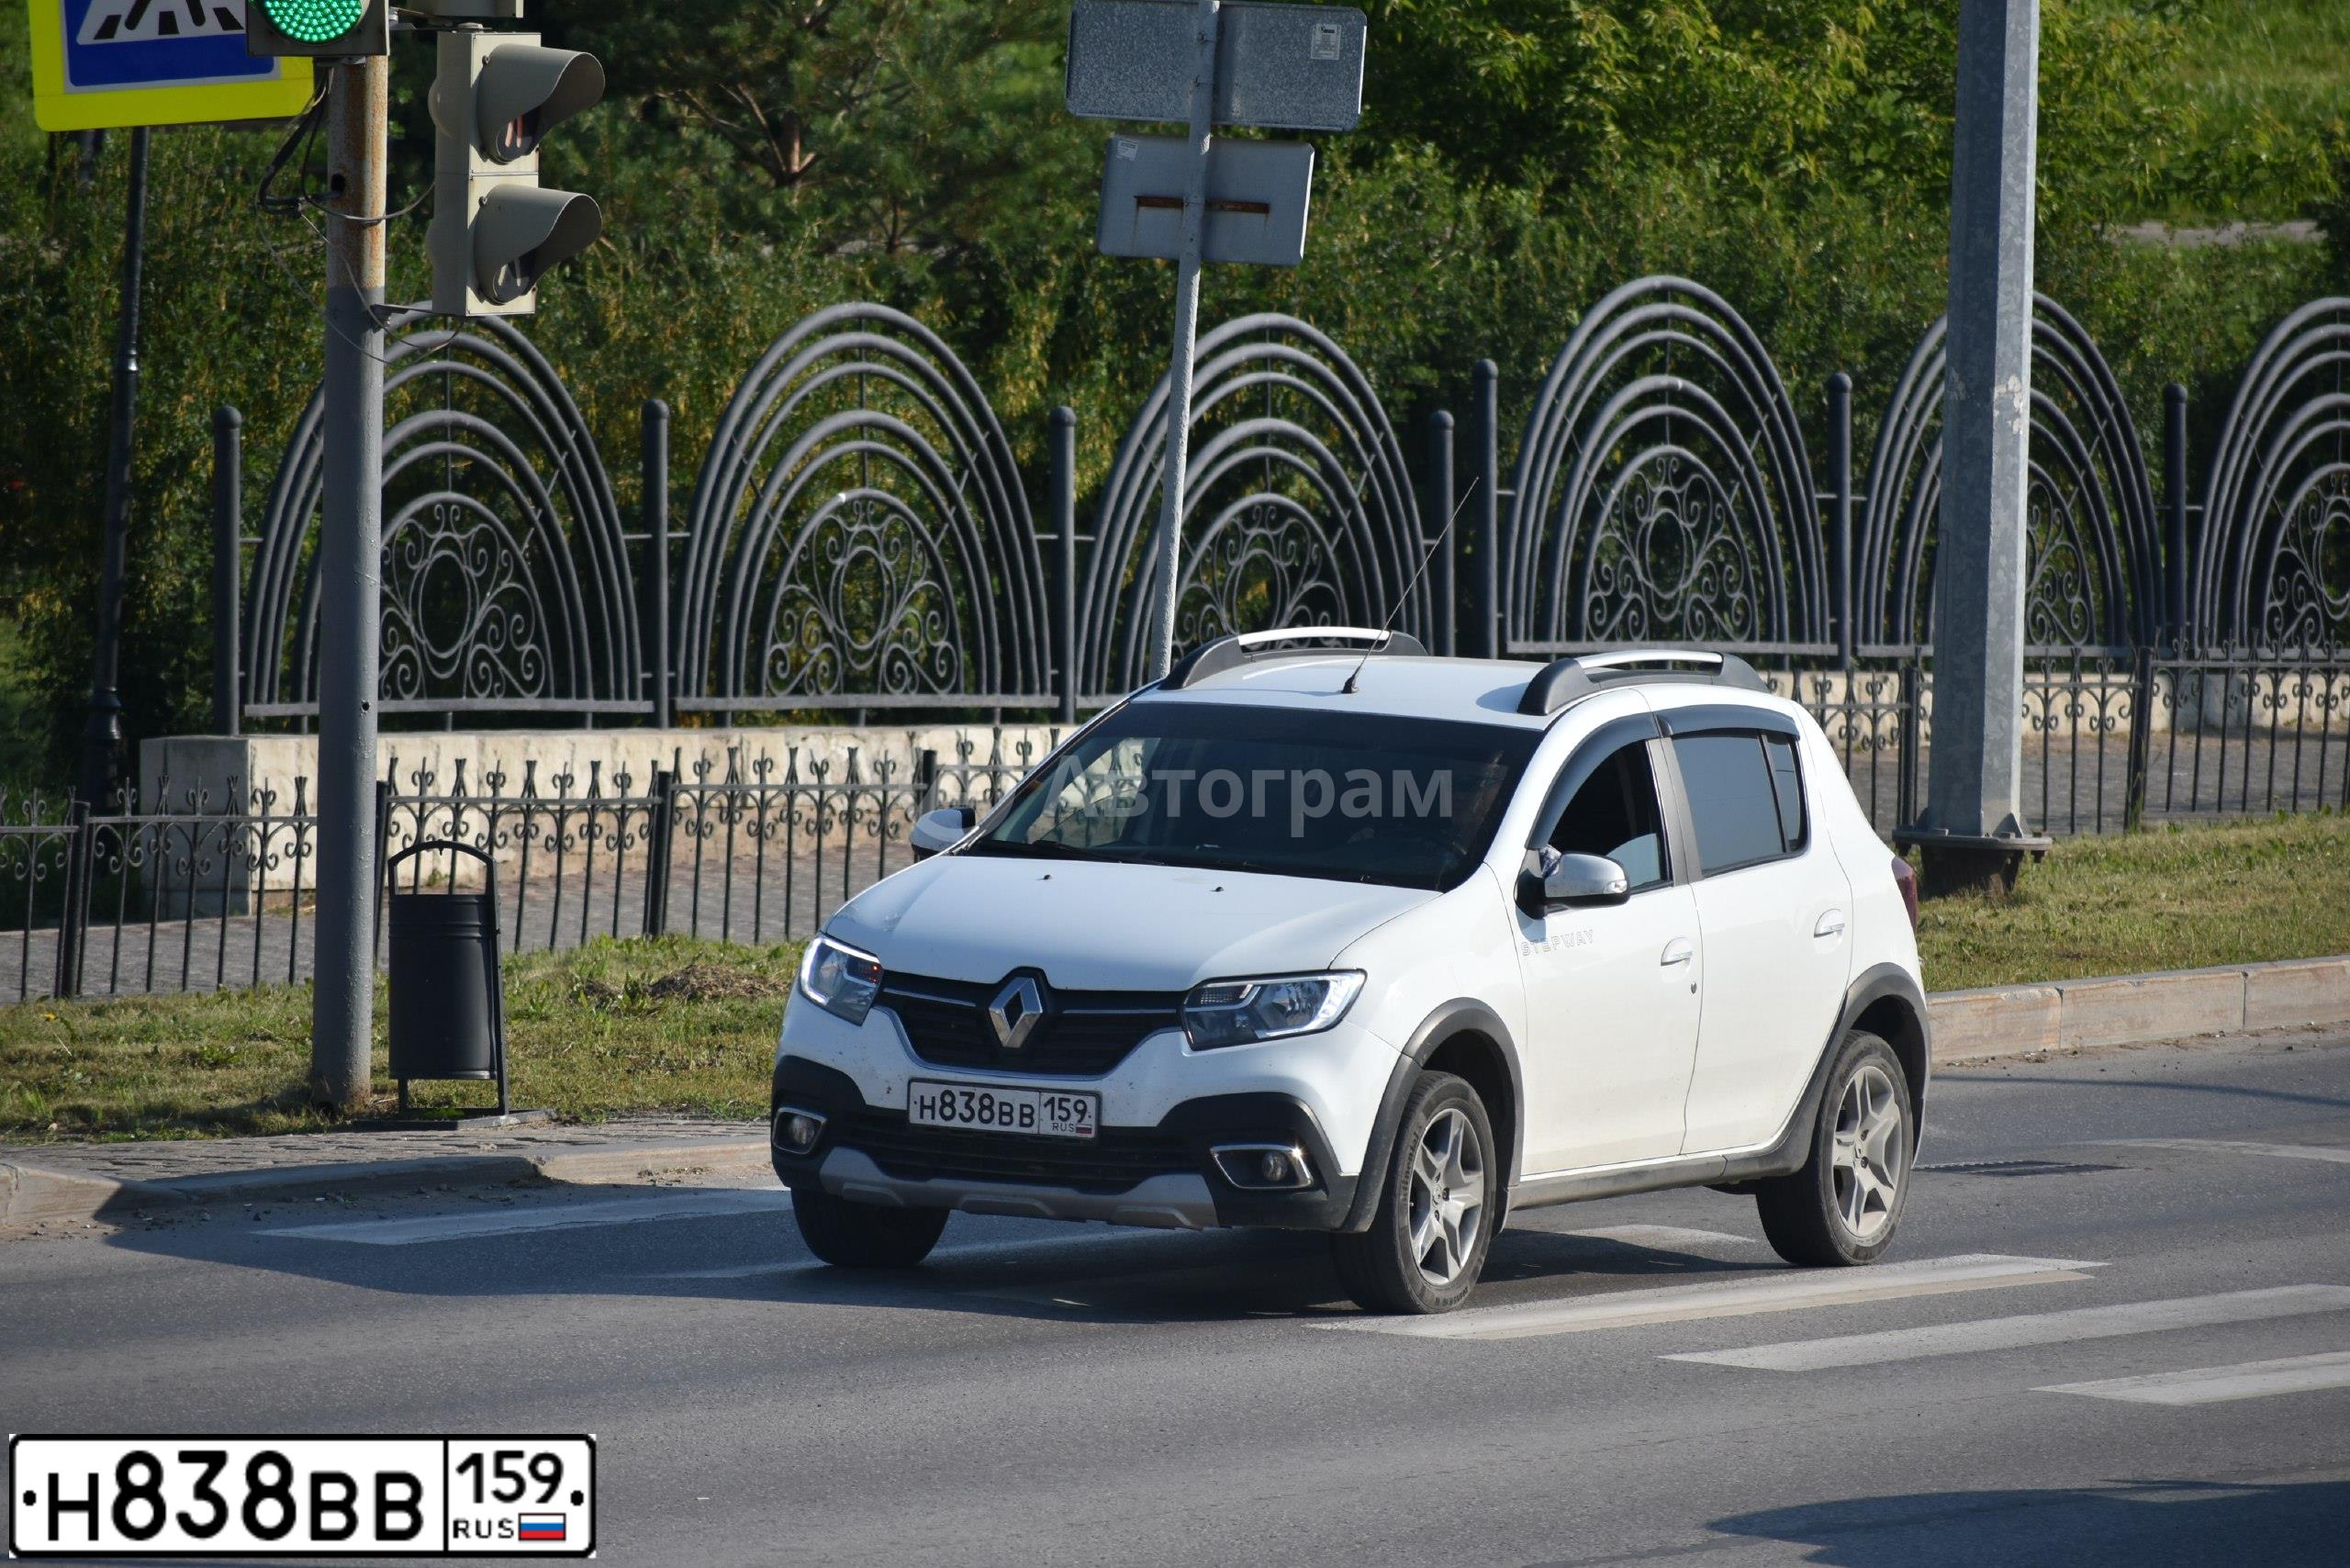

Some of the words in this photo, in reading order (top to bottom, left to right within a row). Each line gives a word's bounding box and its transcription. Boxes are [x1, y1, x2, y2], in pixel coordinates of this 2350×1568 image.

[1521, 929, 1594, 956] STEPWAY
[920, 1090, 1035, 1127] Н838ВВ
[1044, 1097, 1088, 1123] 159
[1052, 1123, 1074, 1132] RUS
